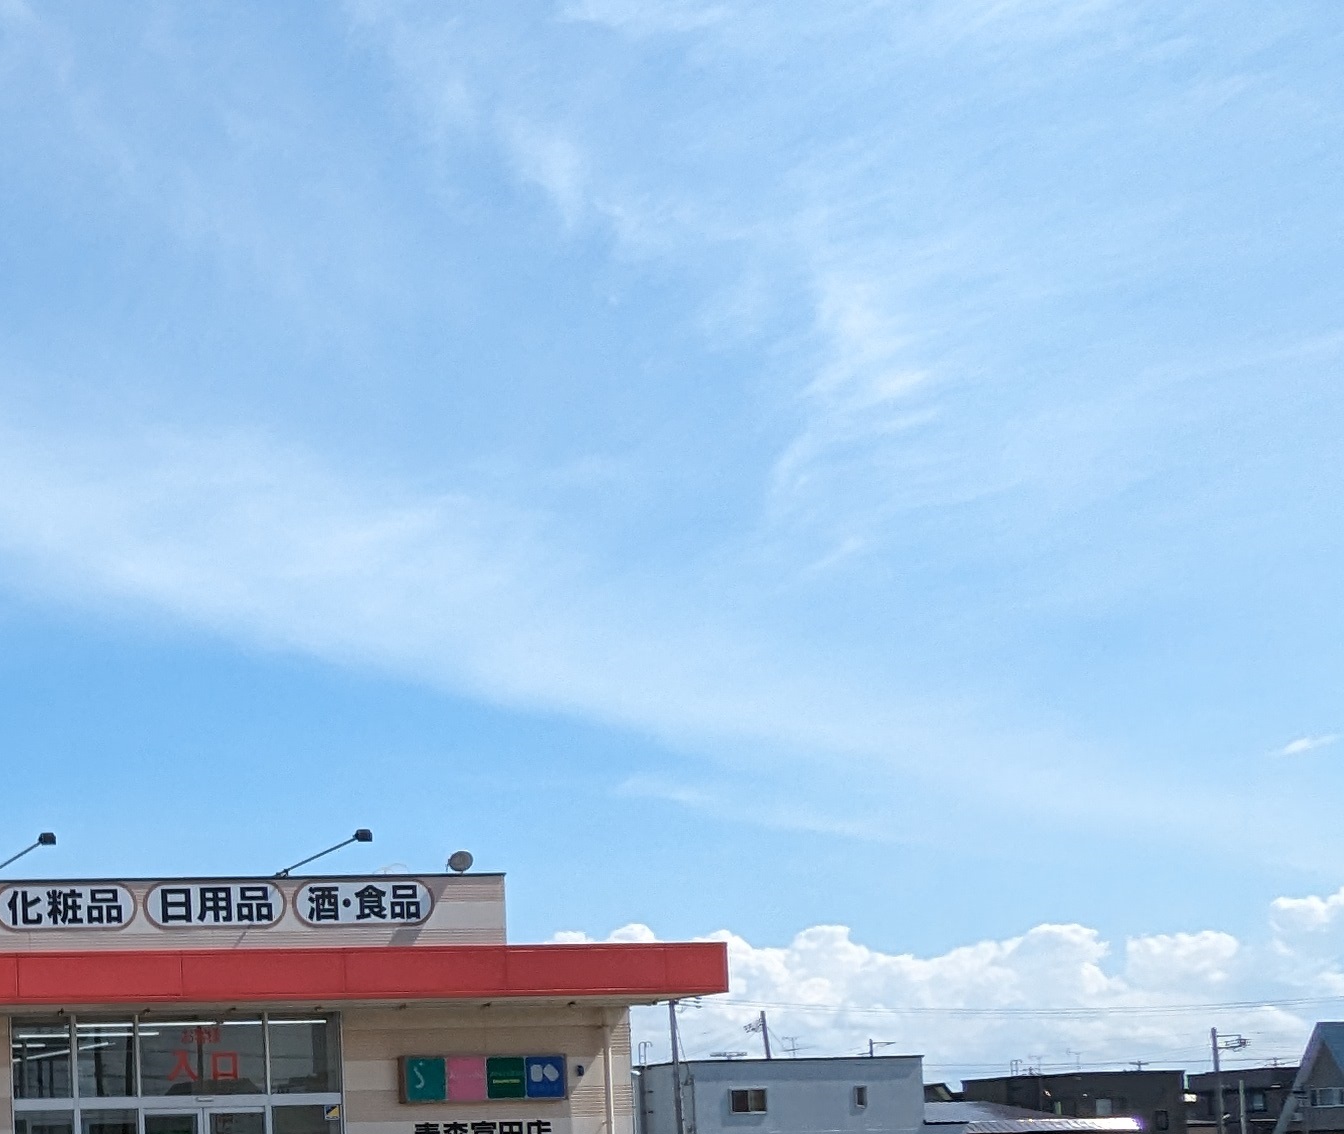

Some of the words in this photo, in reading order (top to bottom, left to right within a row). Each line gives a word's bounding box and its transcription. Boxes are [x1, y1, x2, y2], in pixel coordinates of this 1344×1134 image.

[8, 889, 123, 926] 化粧品
[161, 886, 274, 923] 日用品
[308, 885, 422, 921] 酒・食品
[167, 1050, 239, 1081] 入口
